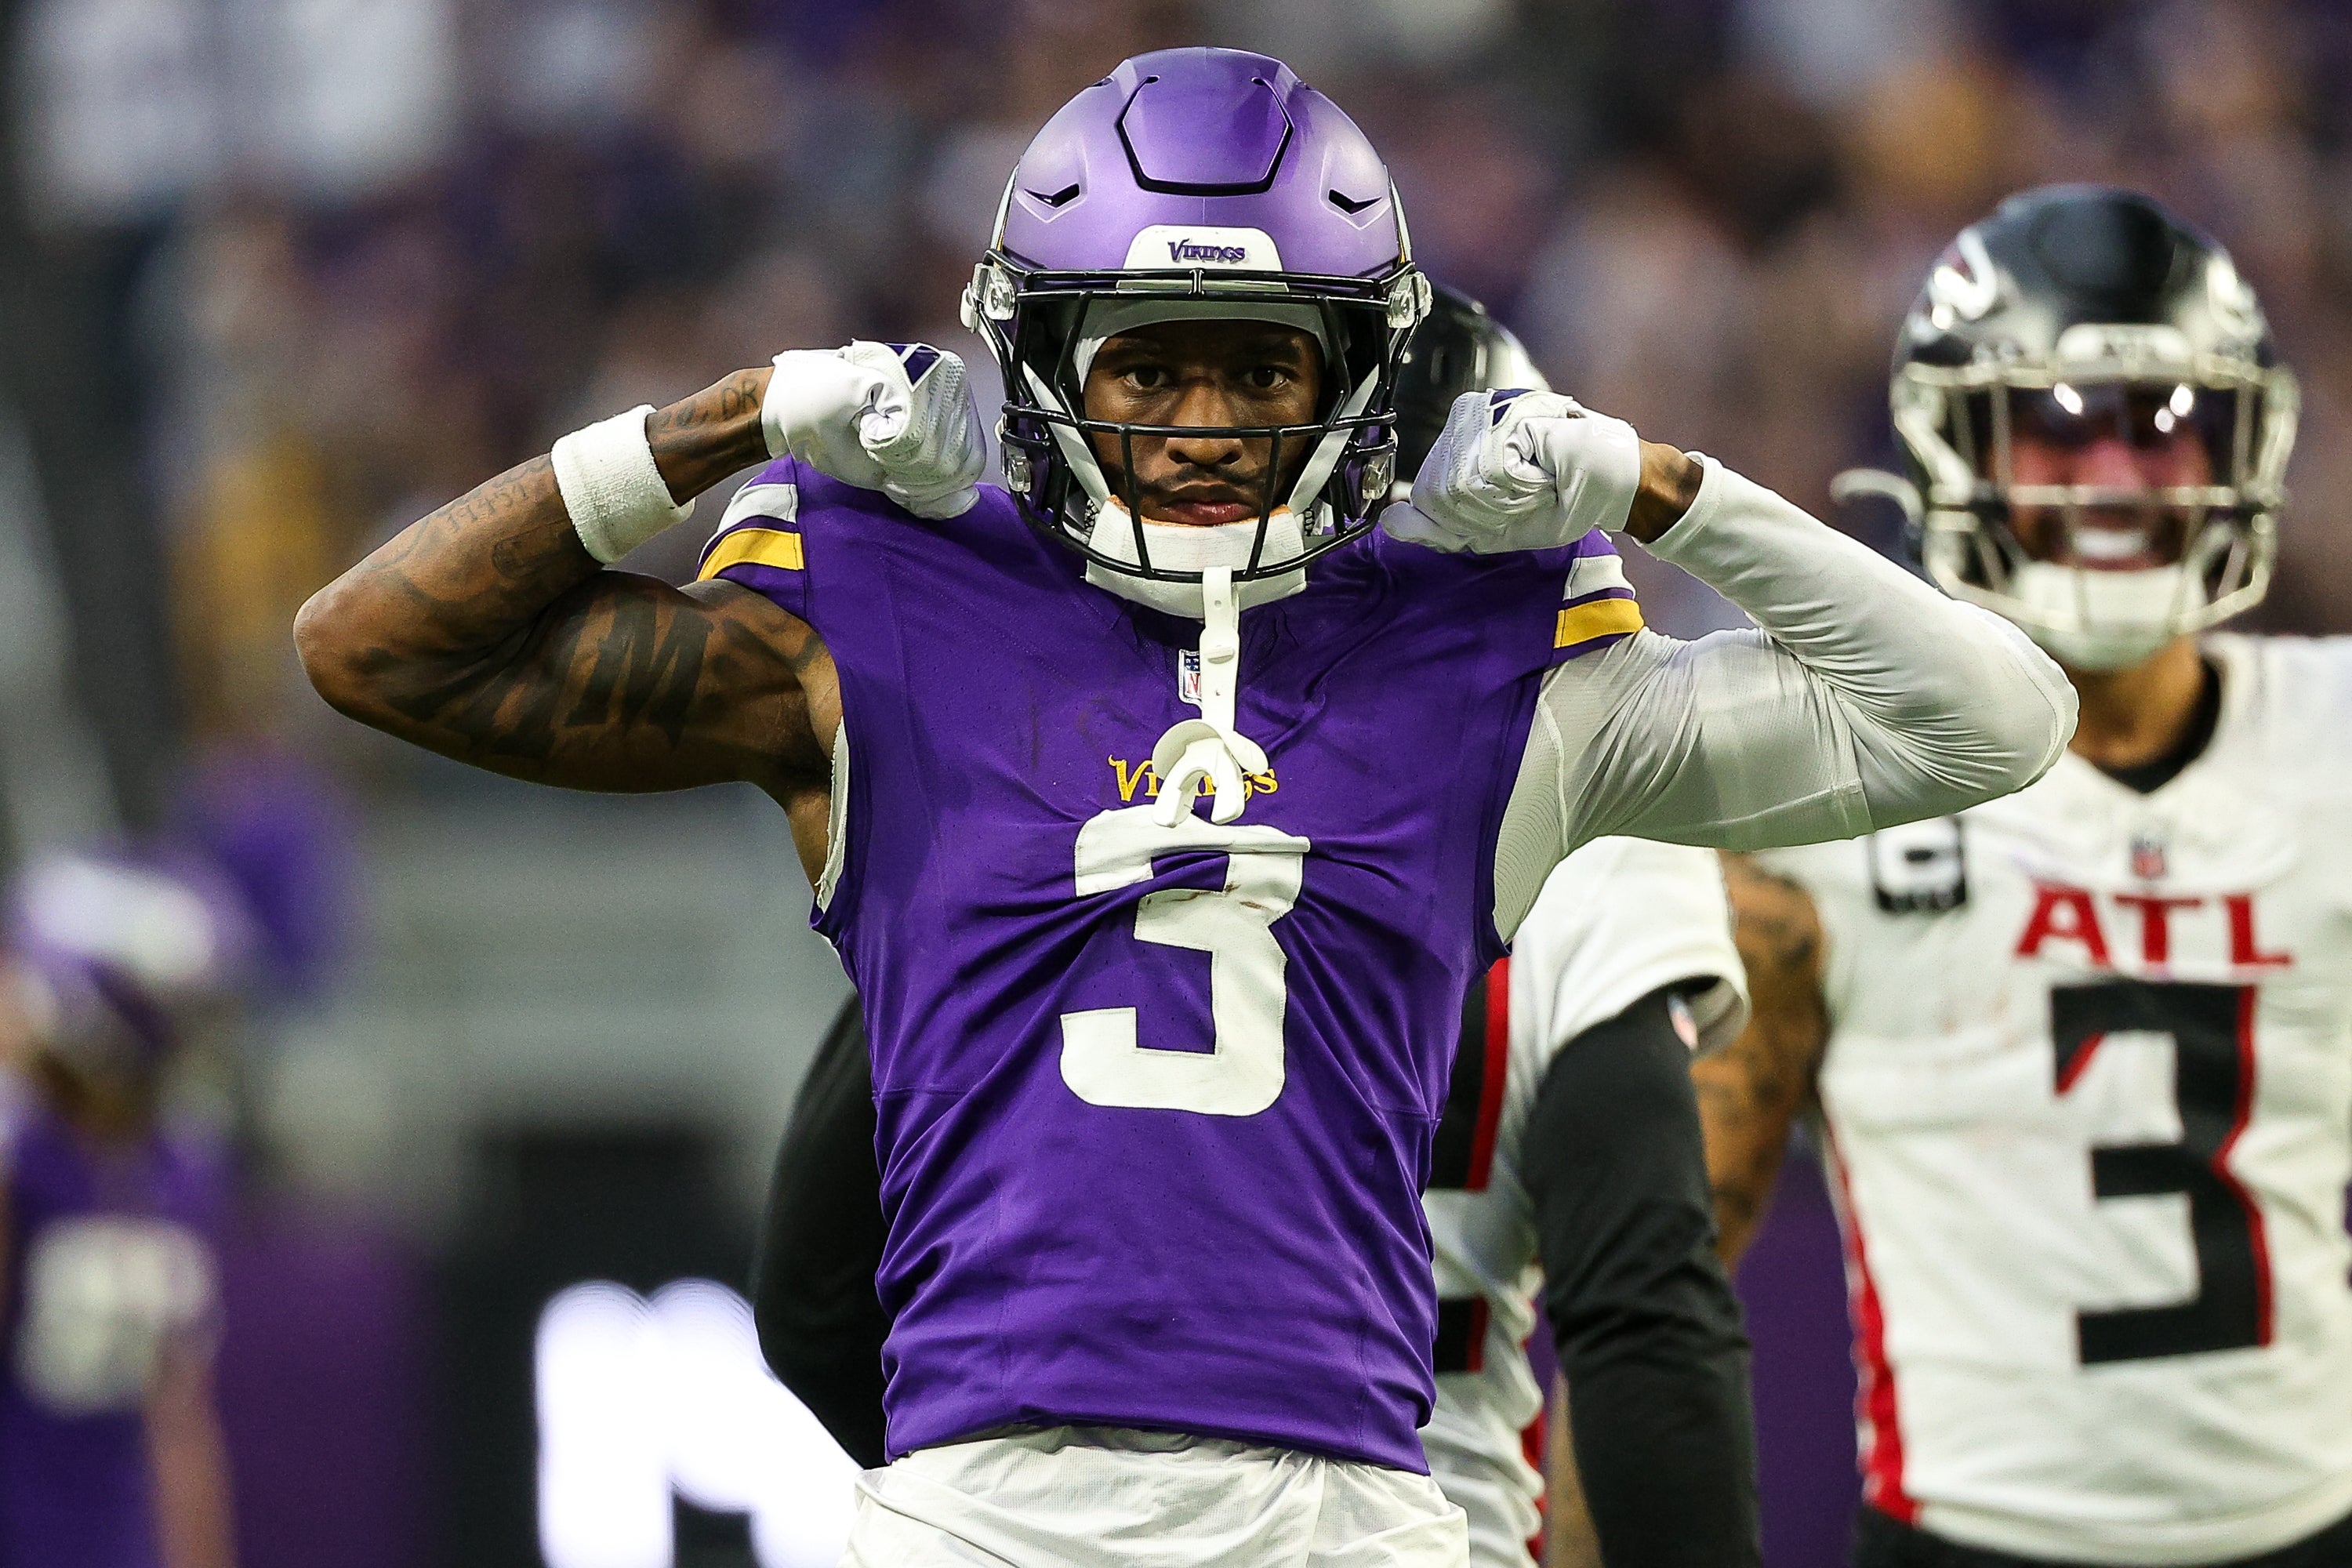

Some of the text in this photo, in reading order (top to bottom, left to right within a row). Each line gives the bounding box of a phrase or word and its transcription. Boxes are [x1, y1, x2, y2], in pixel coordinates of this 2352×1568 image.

[1060, 804, 1311, 1117] 3
[2012, 880, 2294, 969] ATL
[2049, 980, 2277, 1367] 3
